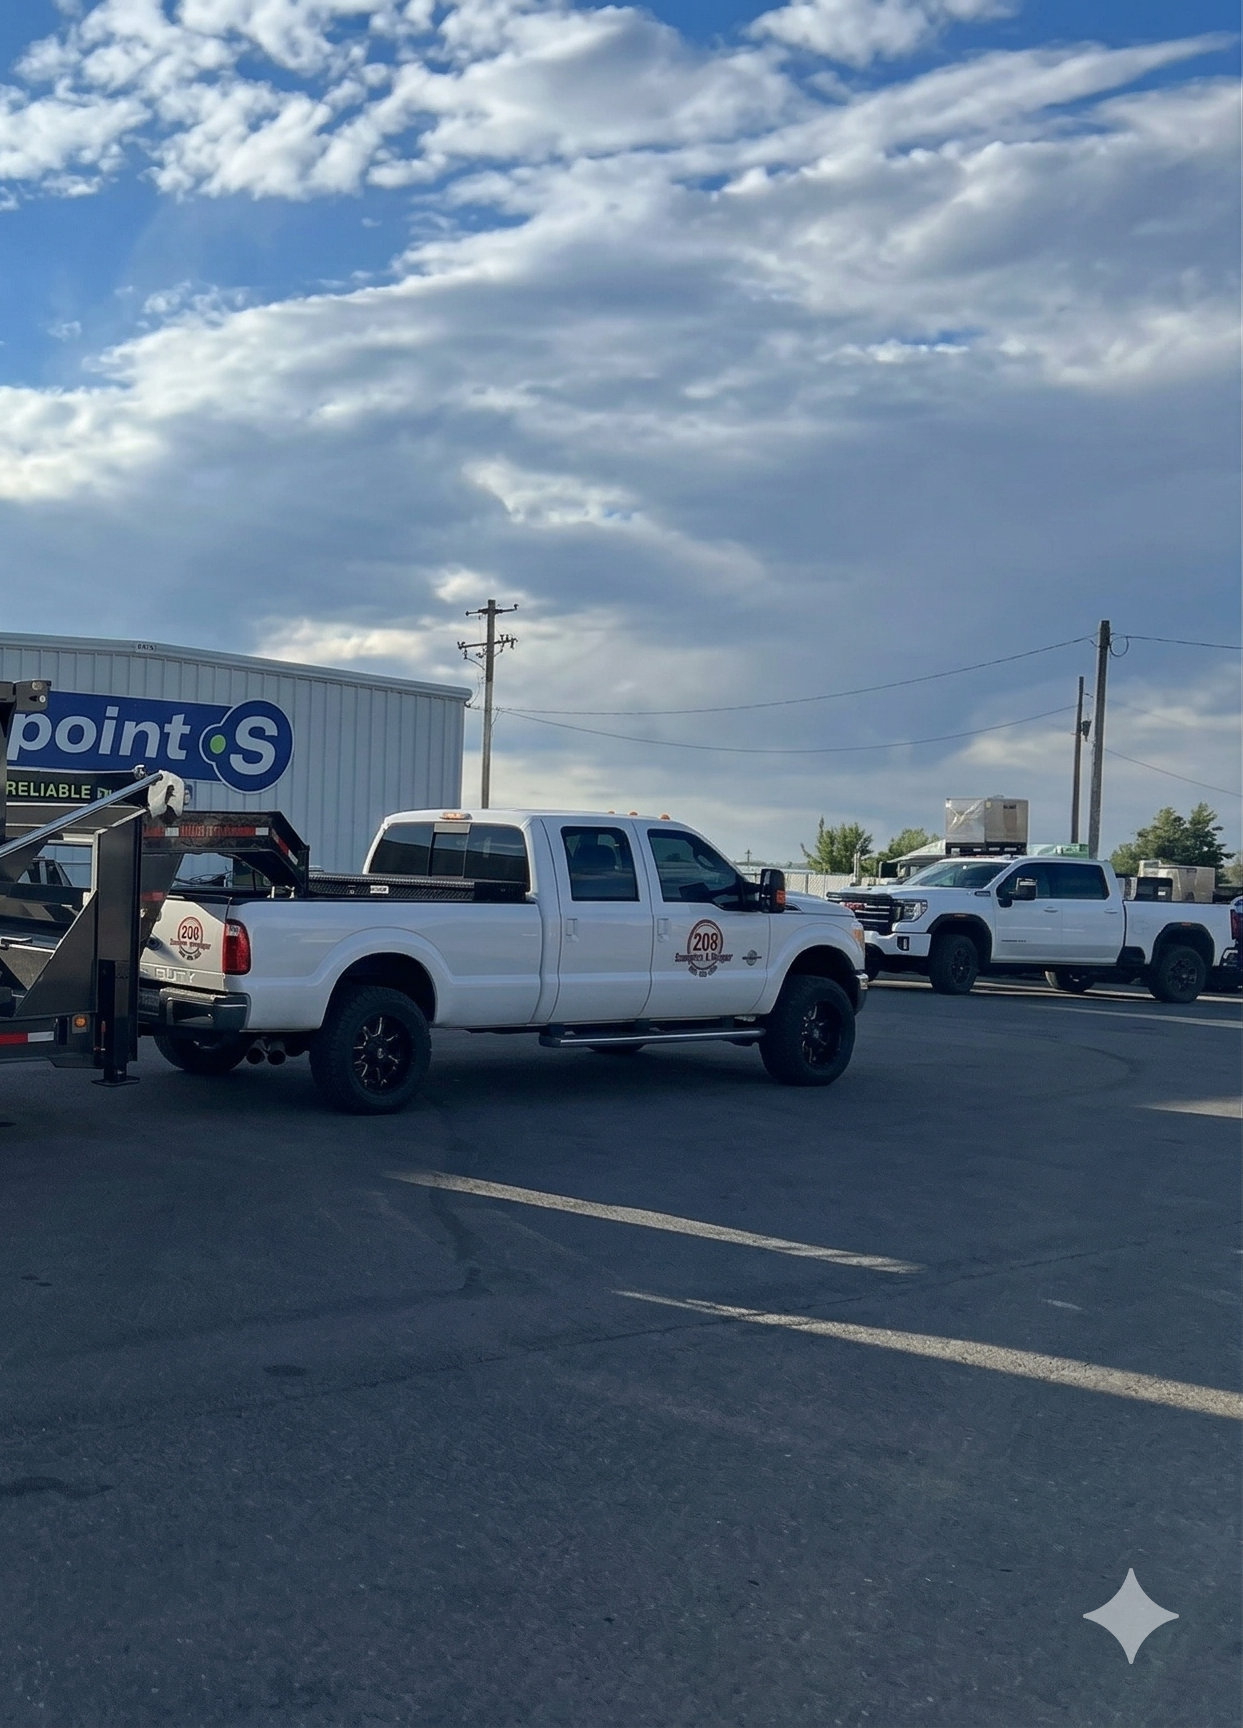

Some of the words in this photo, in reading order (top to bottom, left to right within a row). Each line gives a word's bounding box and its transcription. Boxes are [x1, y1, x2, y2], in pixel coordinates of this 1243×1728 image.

[7, 706, 191, 761] point
[229, 716, 278, 775] S
[5, 781, 91, 799] RELIABLE
[693, 932, 718, 951] 208
